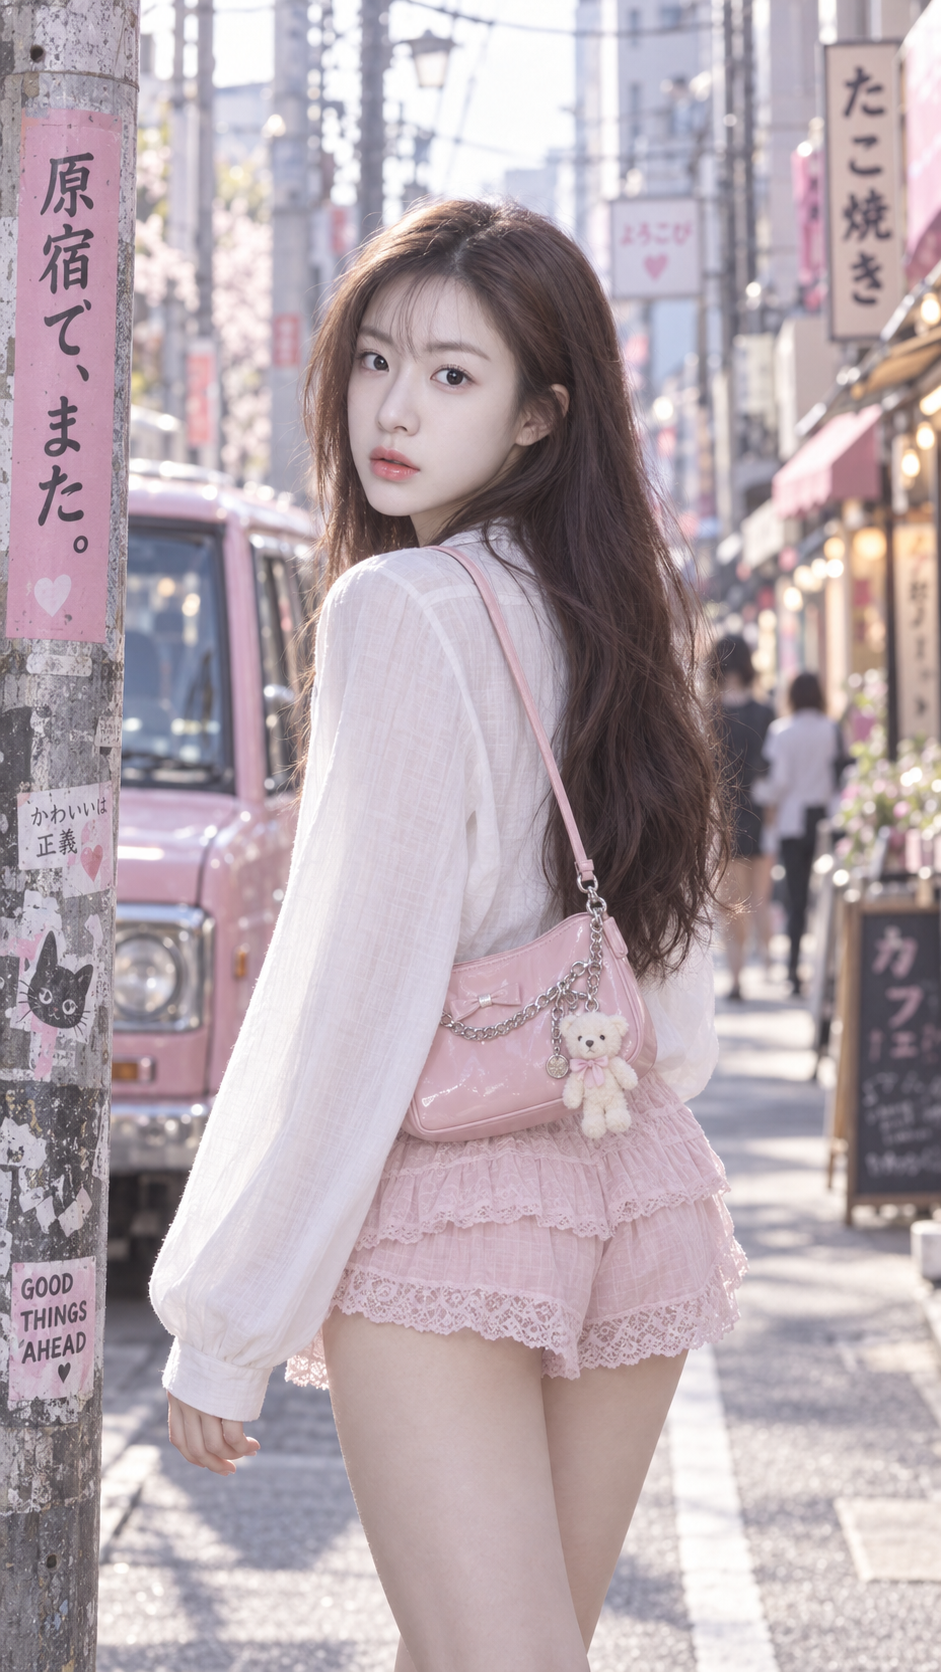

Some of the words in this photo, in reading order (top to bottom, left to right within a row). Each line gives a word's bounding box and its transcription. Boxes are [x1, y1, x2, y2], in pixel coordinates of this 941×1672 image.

[842, 66, 893, 306] たこ焼き
[38, 152, 95, 554] 原宿で、また。
[31, 797, 108, 827] かわいいは
[36, 828, 78, 857] 正義
[21, 1272, 74, 1300] GOOD
[20, 1300, 87, 1332] THINGS
[21, 1331, 87, 1364] AHEAD
